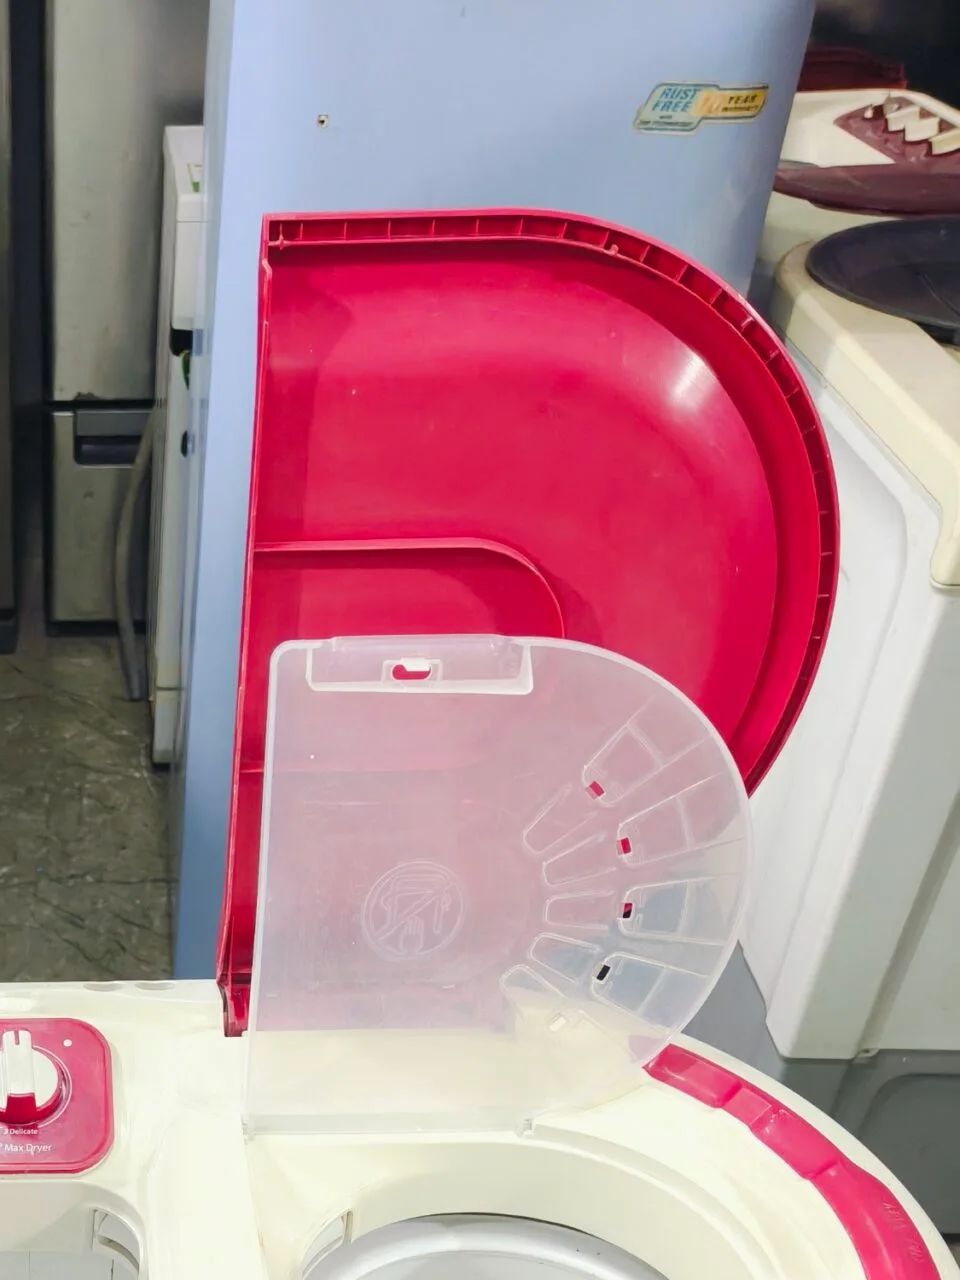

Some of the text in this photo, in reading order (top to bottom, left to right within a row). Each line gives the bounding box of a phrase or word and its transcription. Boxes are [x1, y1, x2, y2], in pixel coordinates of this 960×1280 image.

[658, 87, 701, 99] RUST
[727, 94, 759, 105] YEAR
[651, 100, 692, 112] FREE
[9, 1127, 38, 1136] Delicate
[4, 1142, 52, 1155] Max Dryer
